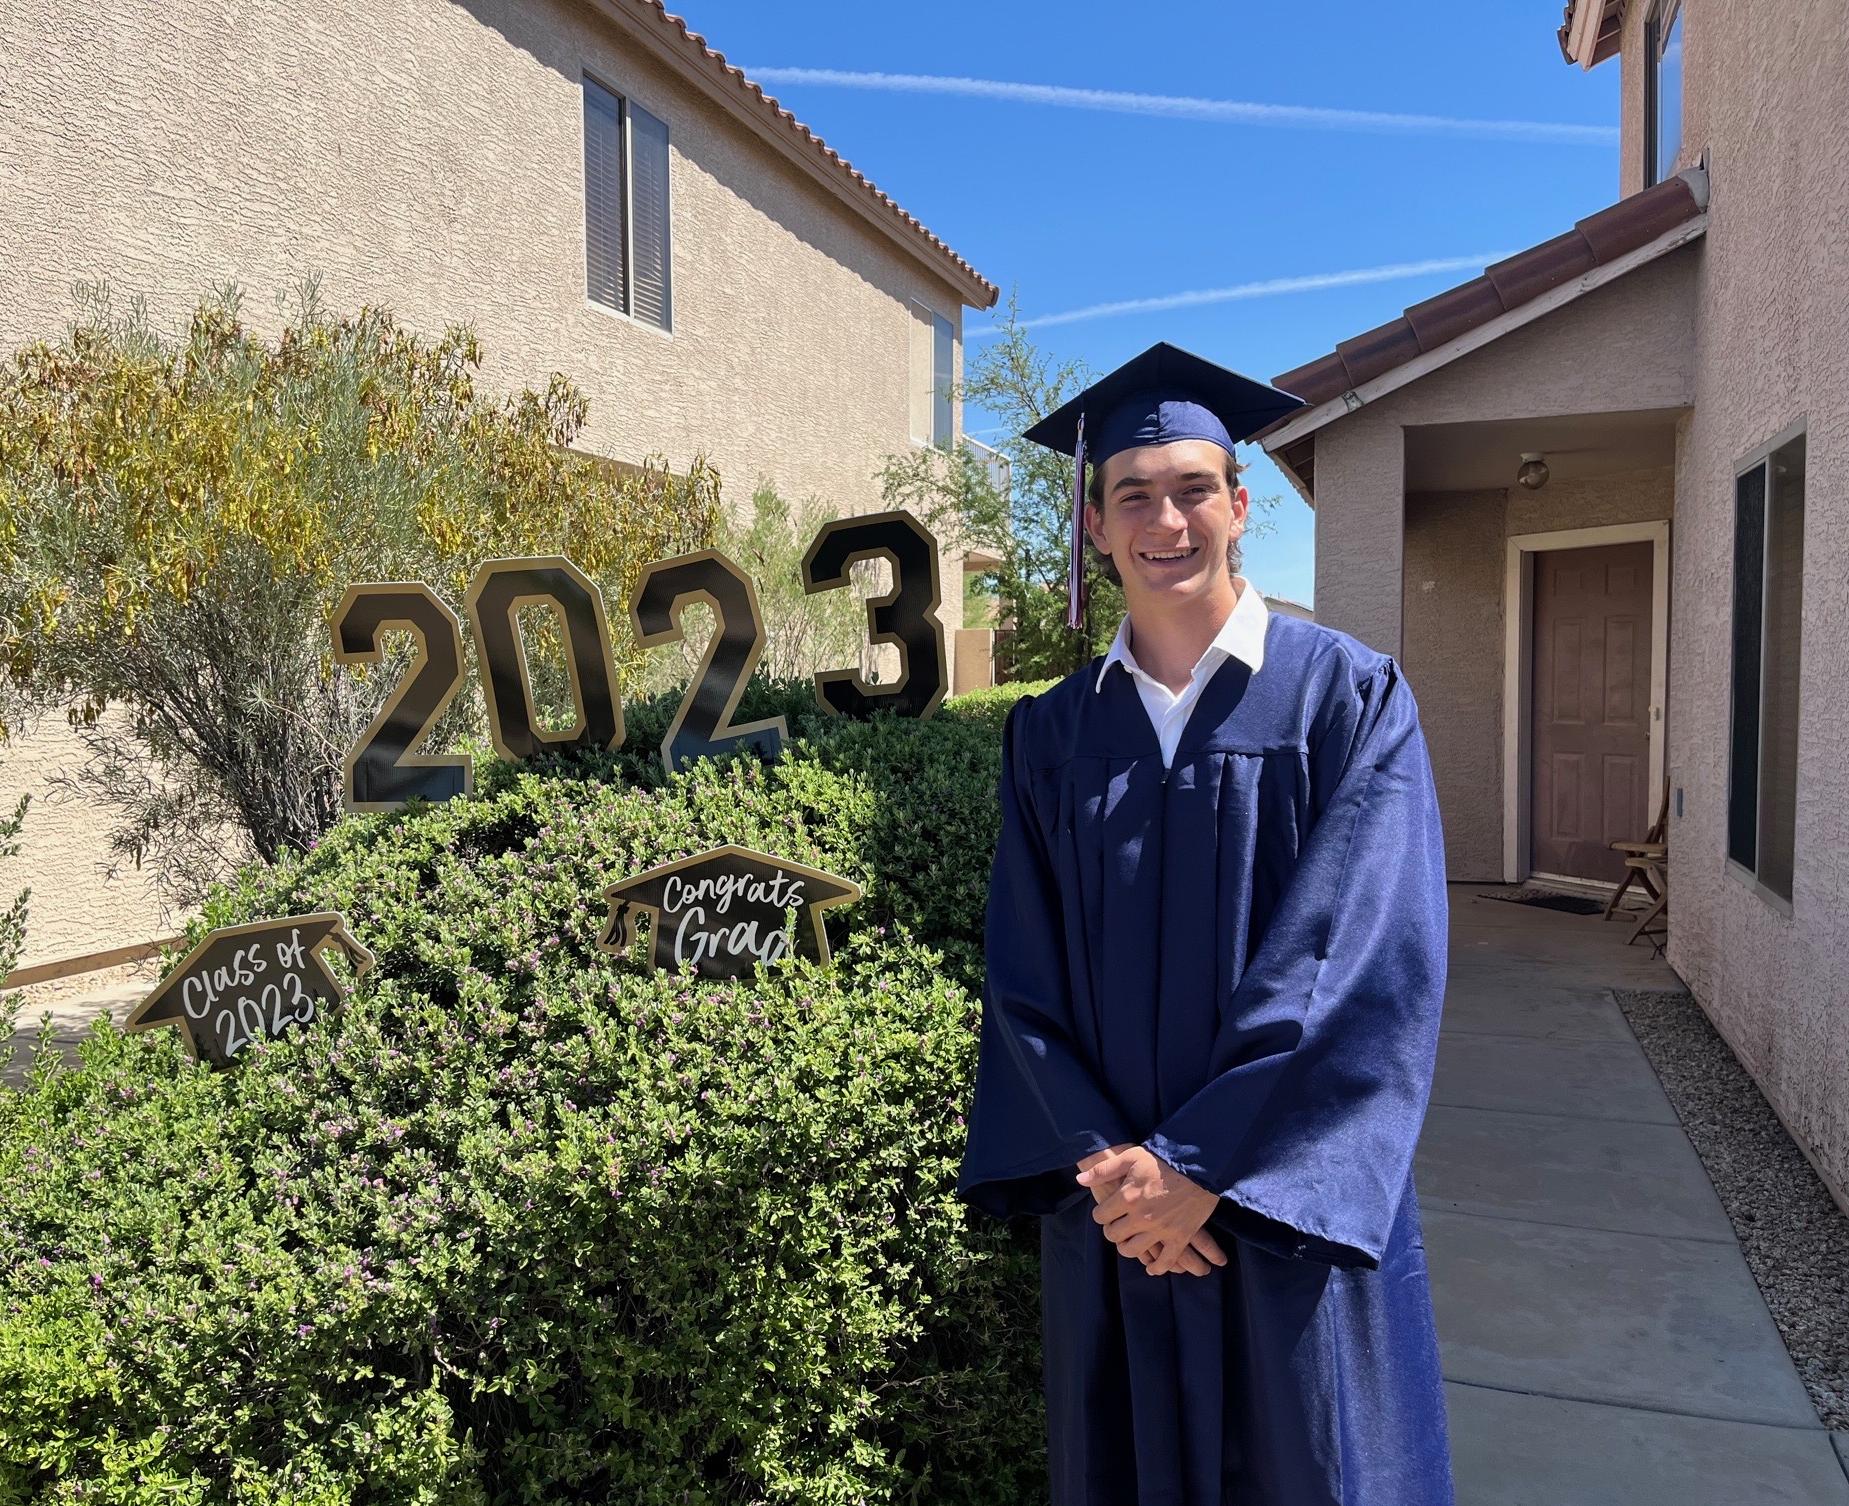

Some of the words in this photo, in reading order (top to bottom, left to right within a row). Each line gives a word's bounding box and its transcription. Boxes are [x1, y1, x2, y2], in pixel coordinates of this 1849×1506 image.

[329, 510, 949, 813] 2023
[663, 870, 805, 914] Congrats
[182, 943, 268, 1019] Class
[276, 928, 306, 969] of
[215, 972, 315, 1058] 2023
